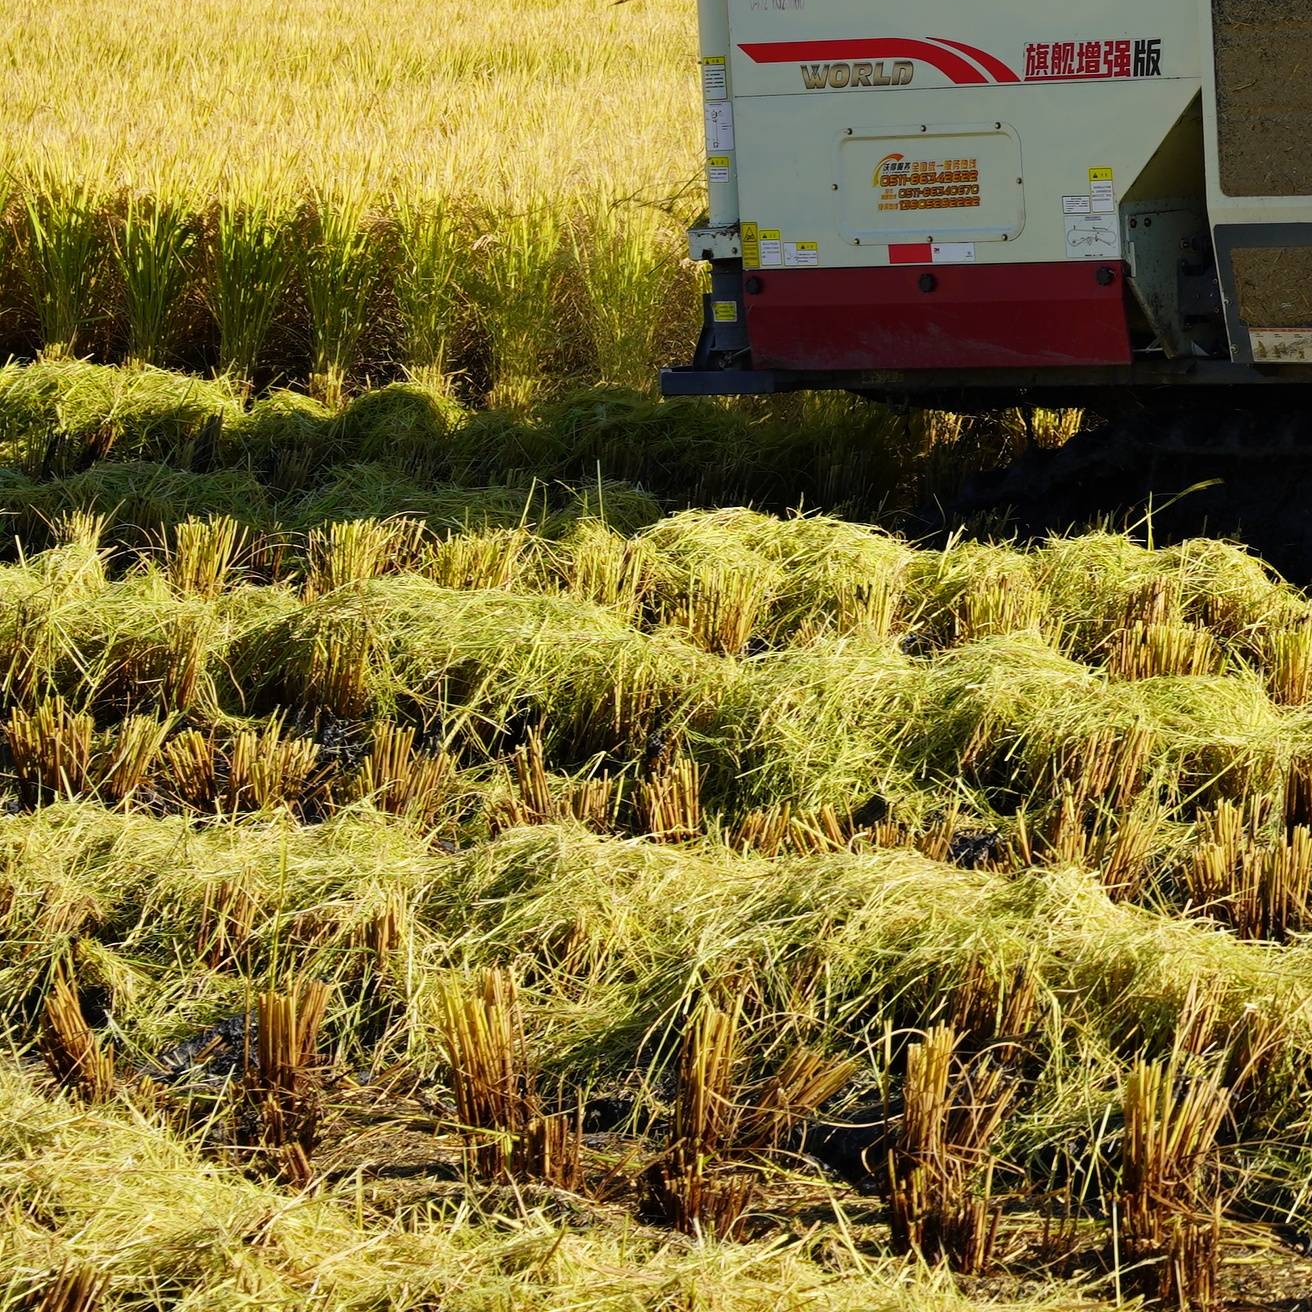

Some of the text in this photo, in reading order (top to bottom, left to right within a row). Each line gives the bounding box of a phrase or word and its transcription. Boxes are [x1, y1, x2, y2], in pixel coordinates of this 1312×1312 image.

[1025, 38, 1162, 77] 旗舰增强版
[800, 61, 914, 90] WORLD
